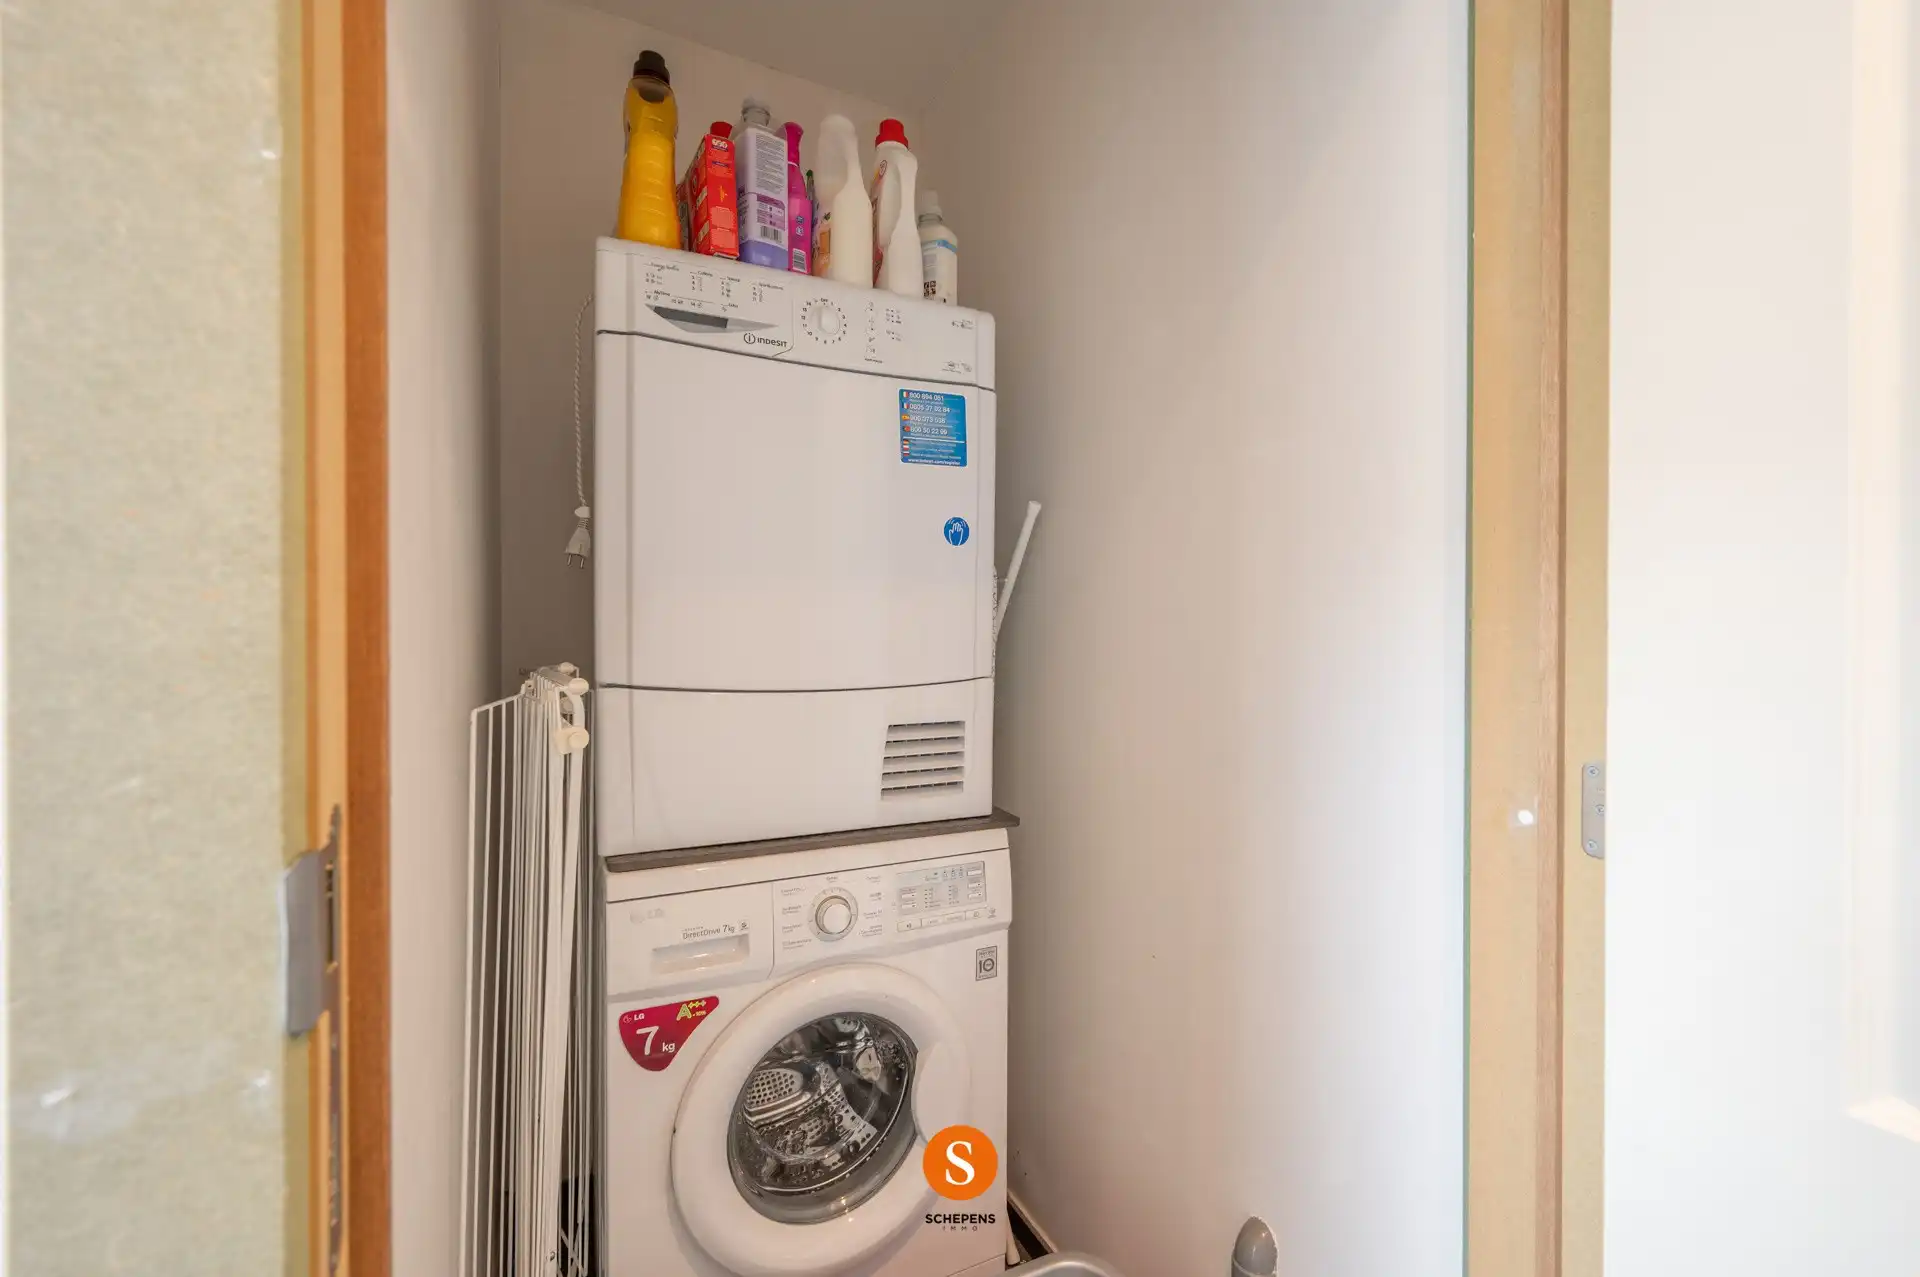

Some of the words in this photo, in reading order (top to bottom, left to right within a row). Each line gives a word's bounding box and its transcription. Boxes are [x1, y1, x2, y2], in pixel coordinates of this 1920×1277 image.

[682, 927, 721, 940] DirectDrive
[633, 1013, 645, 1021] LG
[662, 1042, 676, 1053] kg
